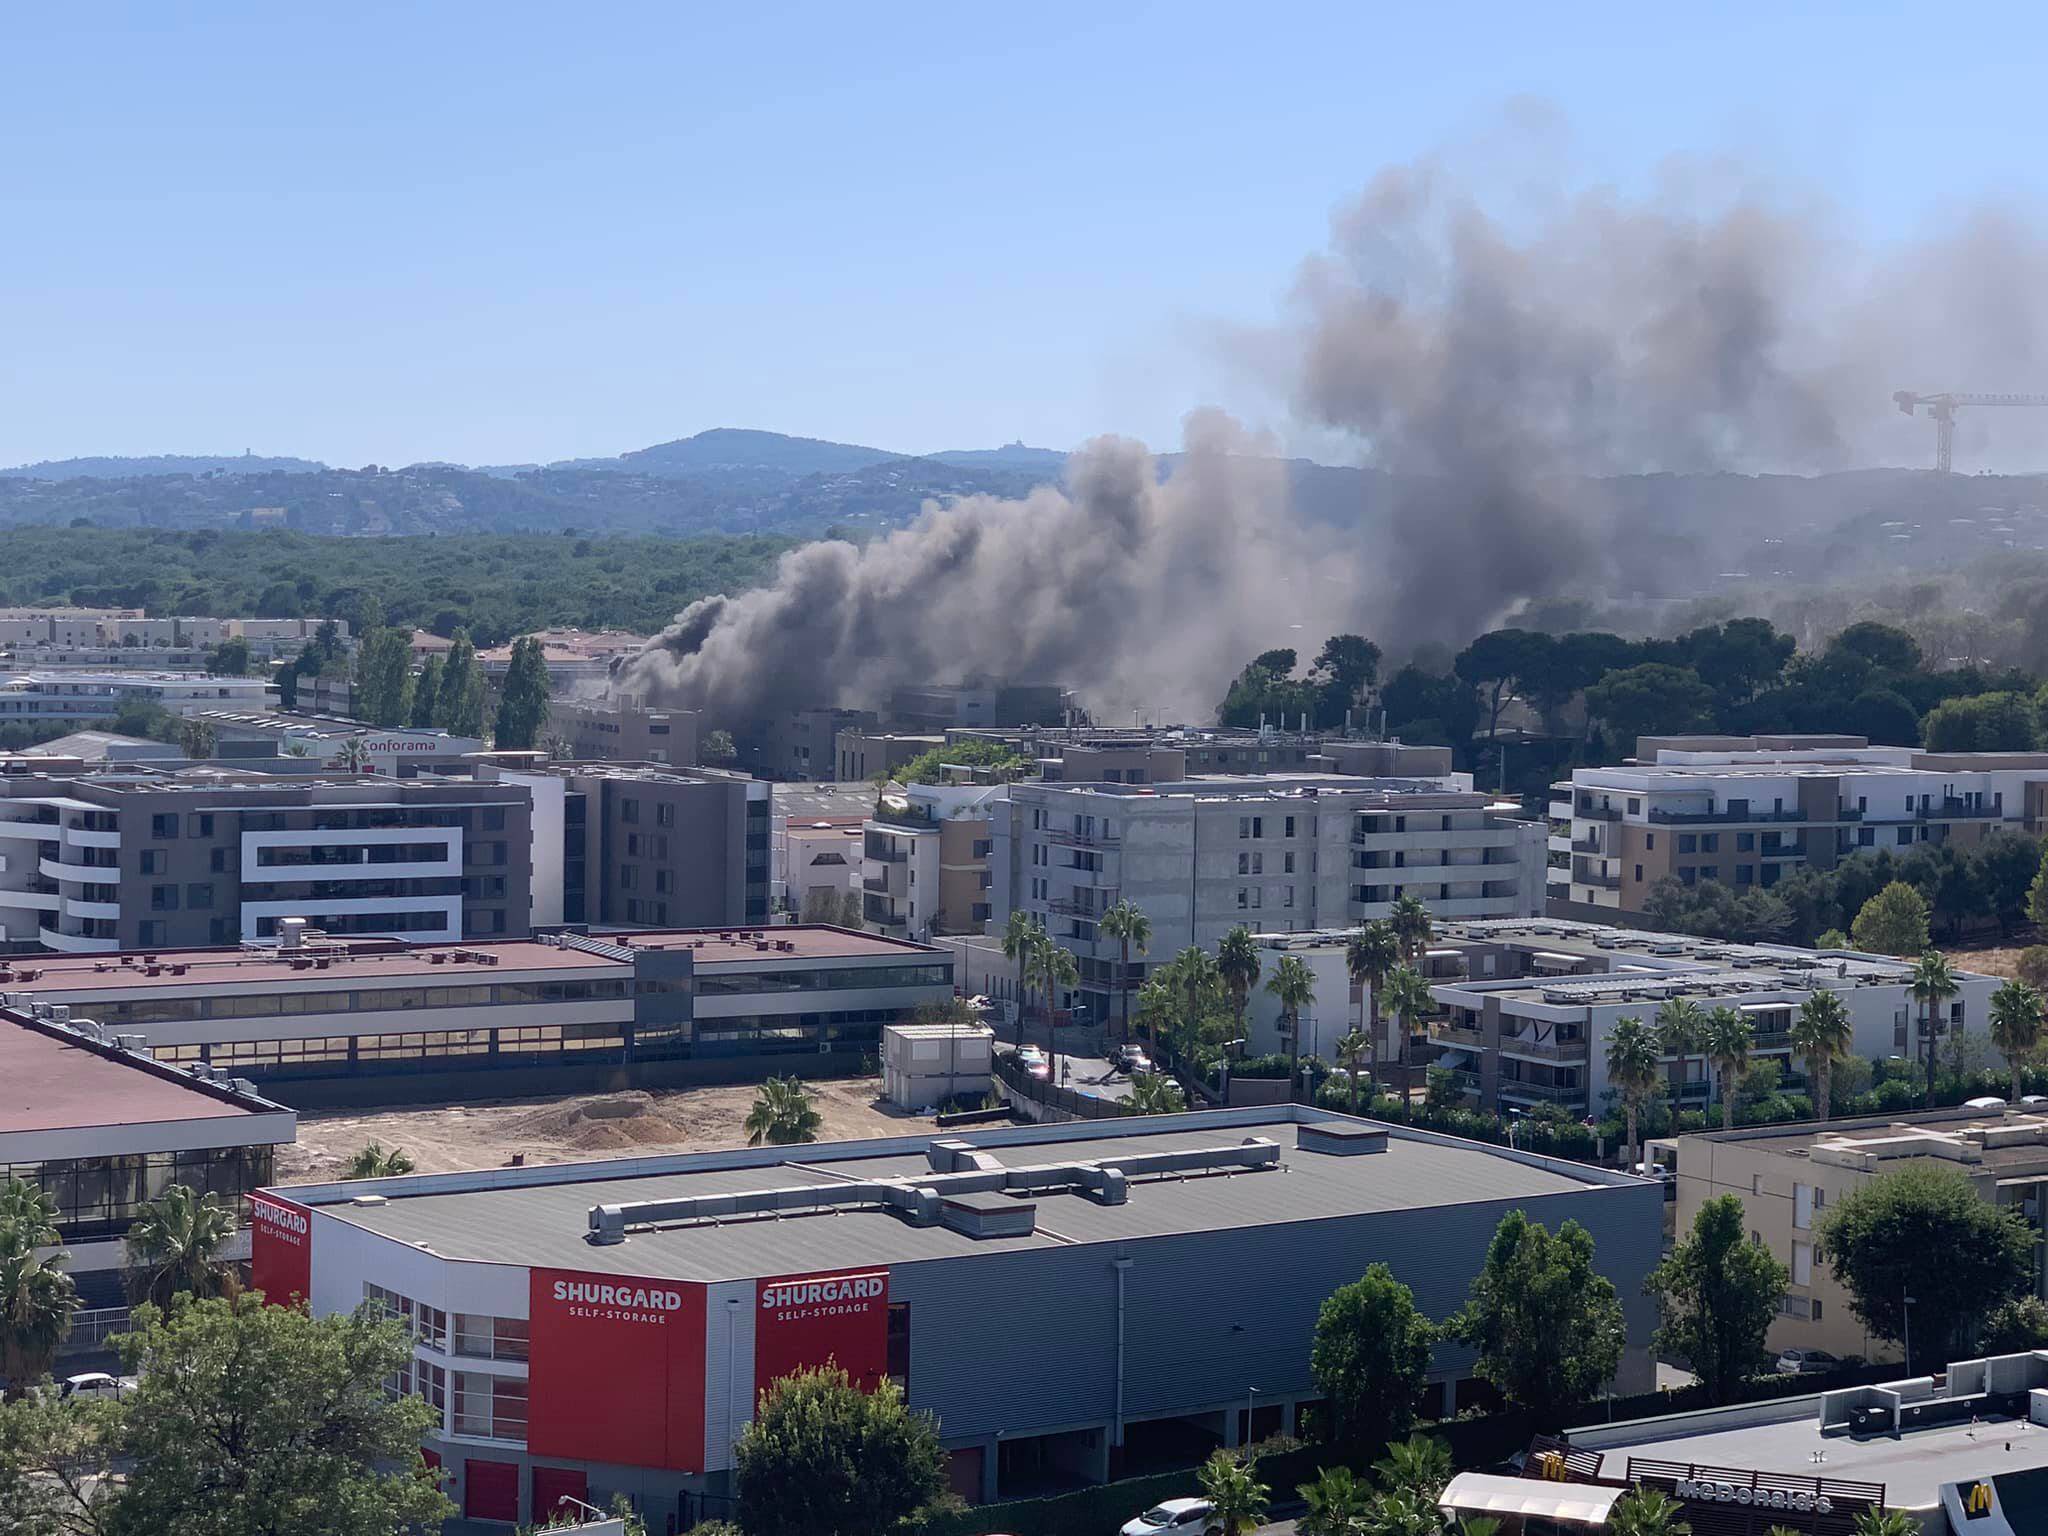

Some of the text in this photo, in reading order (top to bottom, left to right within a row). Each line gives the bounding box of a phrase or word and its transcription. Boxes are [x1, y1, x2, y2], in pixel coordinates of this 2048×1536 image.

[361, 739, 436, 752] Conforama
[254, 1201, 307, 1235] SHURGARD
[260, 1223, 301, 1246] SELF-STORAGE
[553, 1280, 682, 1310] SHURGARD
[762, 1278, 884, 1309] SHURGARD
[569, 1307, 665, 1324] SELF-STORAGE
[778, 1303, 869, 1321] SELF-STORAGE
[1675, 1478, 1832, 1514] McDonald's
